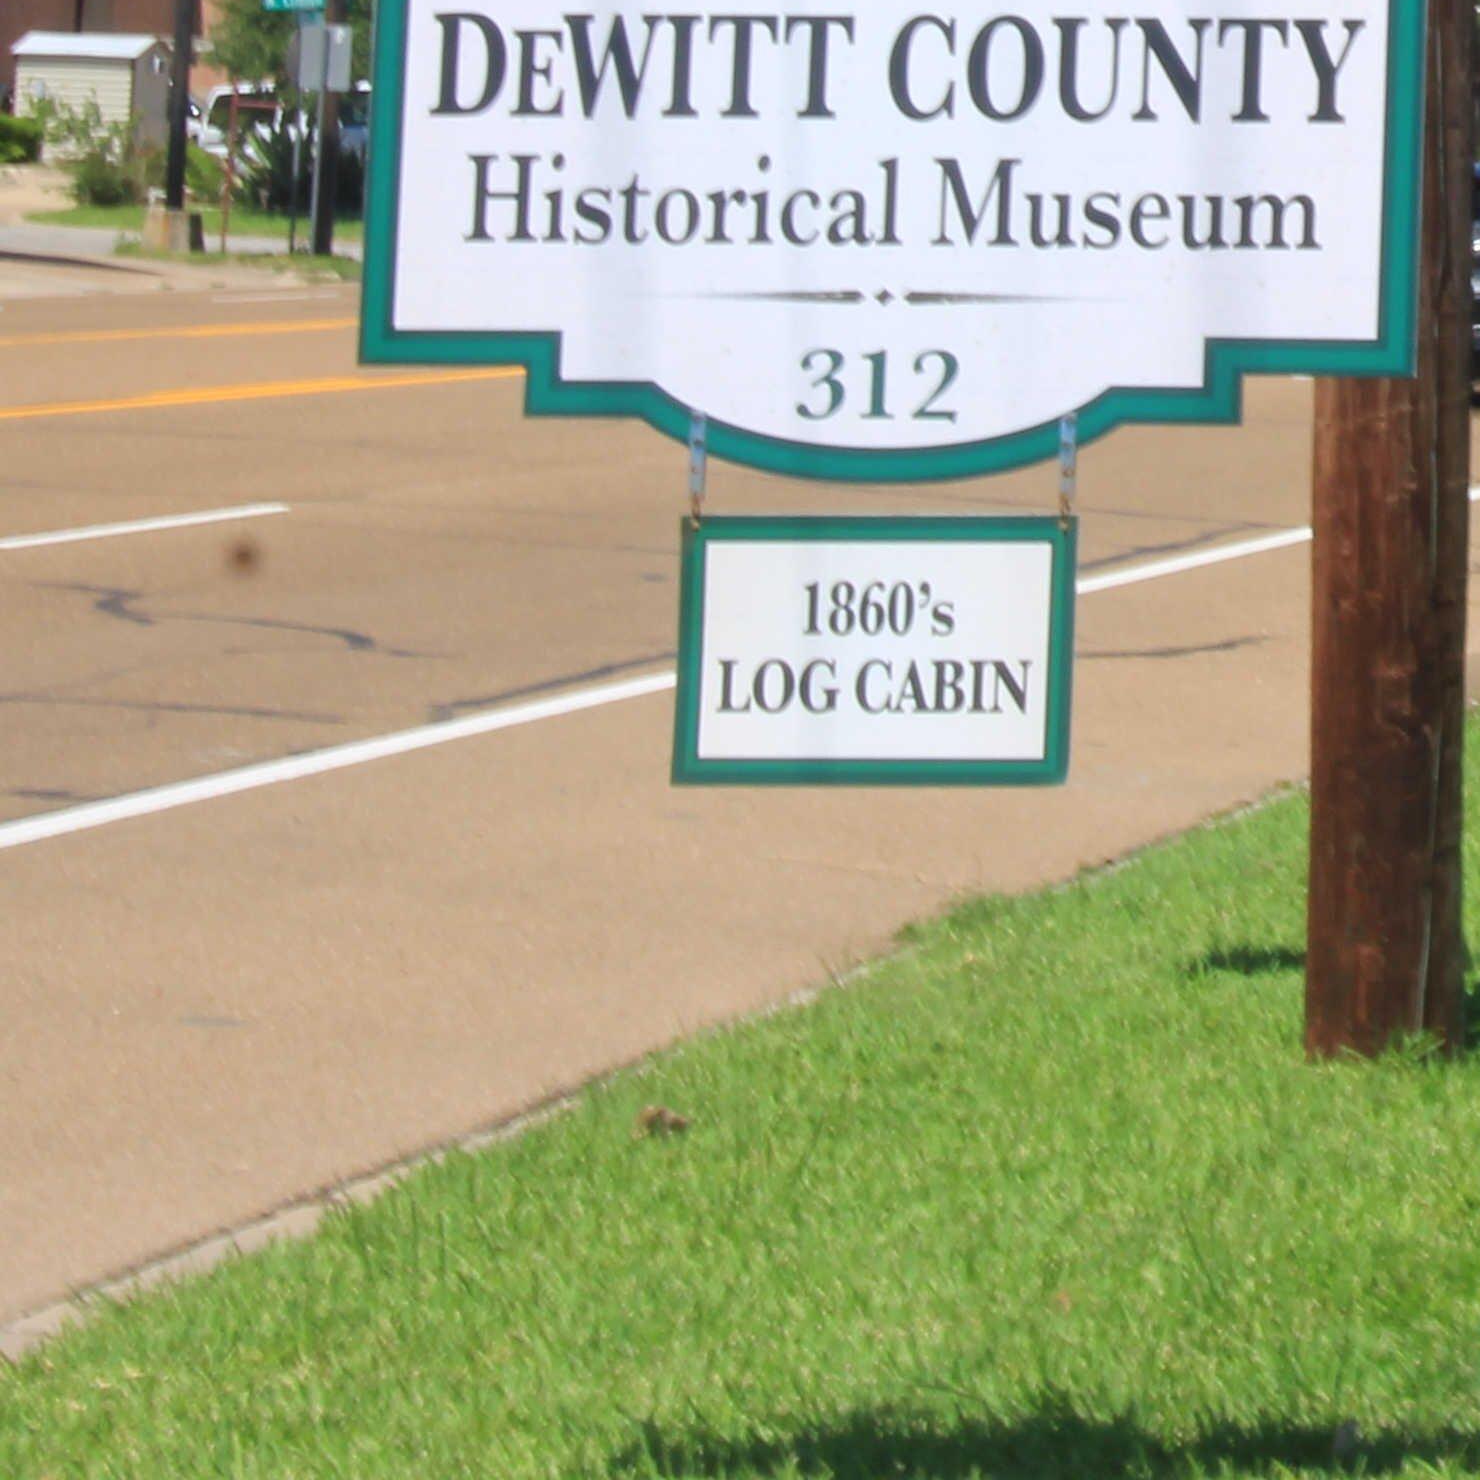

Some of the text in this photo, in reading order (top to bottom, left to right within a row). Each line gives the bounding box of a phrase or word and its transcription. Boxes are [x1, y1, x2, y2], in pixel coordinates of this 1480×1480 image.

[887, 13, 1367, 124] COUNTY
[464, 152, 1321, 251] Historical Museum
[794, 347, 959, 423] 312
[803, 580, 955, 636] 1860's
[716, 658, 1032, 716] LOG CABIN
